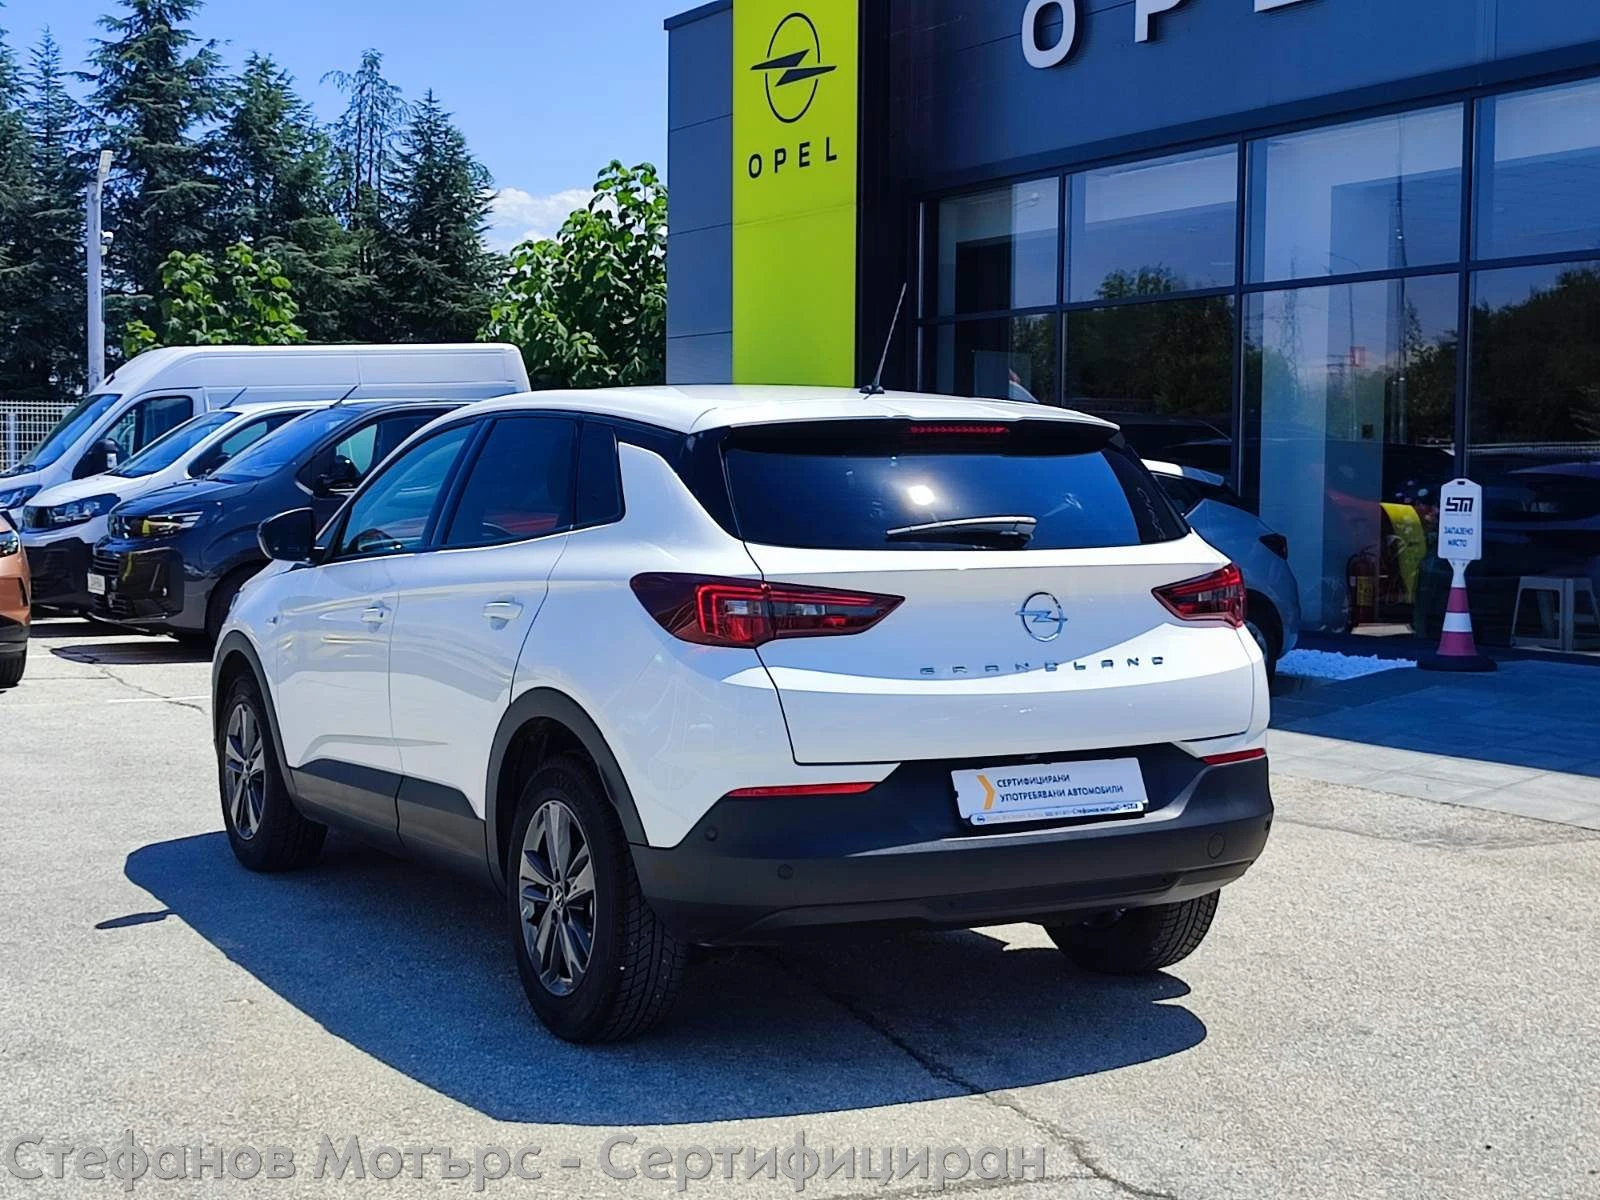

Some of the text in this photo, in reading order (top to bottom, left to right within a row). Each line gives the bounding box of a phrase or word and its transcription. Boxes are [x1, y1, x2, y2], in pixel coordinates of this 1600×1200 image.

[748, 136, 838, 179] OPEL
[919, 655, 1164, 675] GRANDLAND
[997, 774, 1071, 788] СЕРТИФИЦИРАНИ
[1000, 785, 1124, 802] УПОТРЕБЯВАНИ АВТОМОБИЛИ
